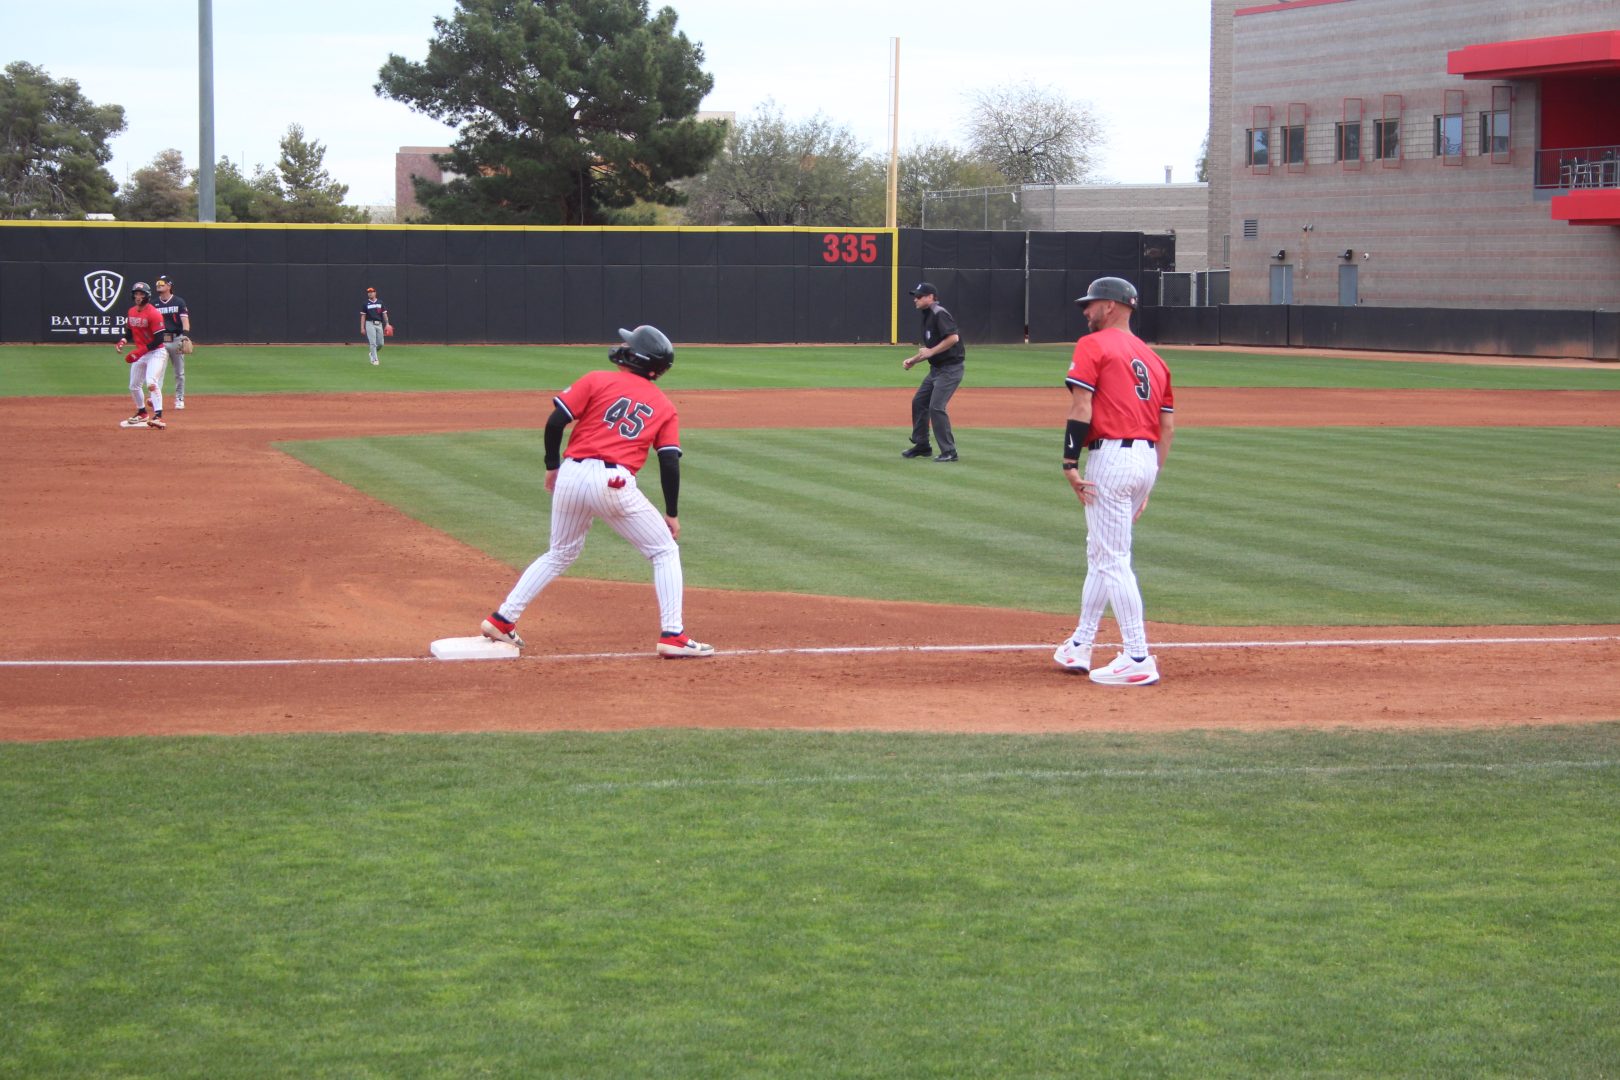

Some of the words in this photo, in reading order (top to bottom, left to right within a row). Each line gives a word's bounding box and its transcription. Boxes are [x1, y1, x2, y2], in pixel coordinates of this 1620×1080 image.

[823, 233, 878, 263] 335
[51, 315, 111, 326] BATTLE
[1130, 358, 1150, 401] 9
[603, 396, 654, 440] 45
